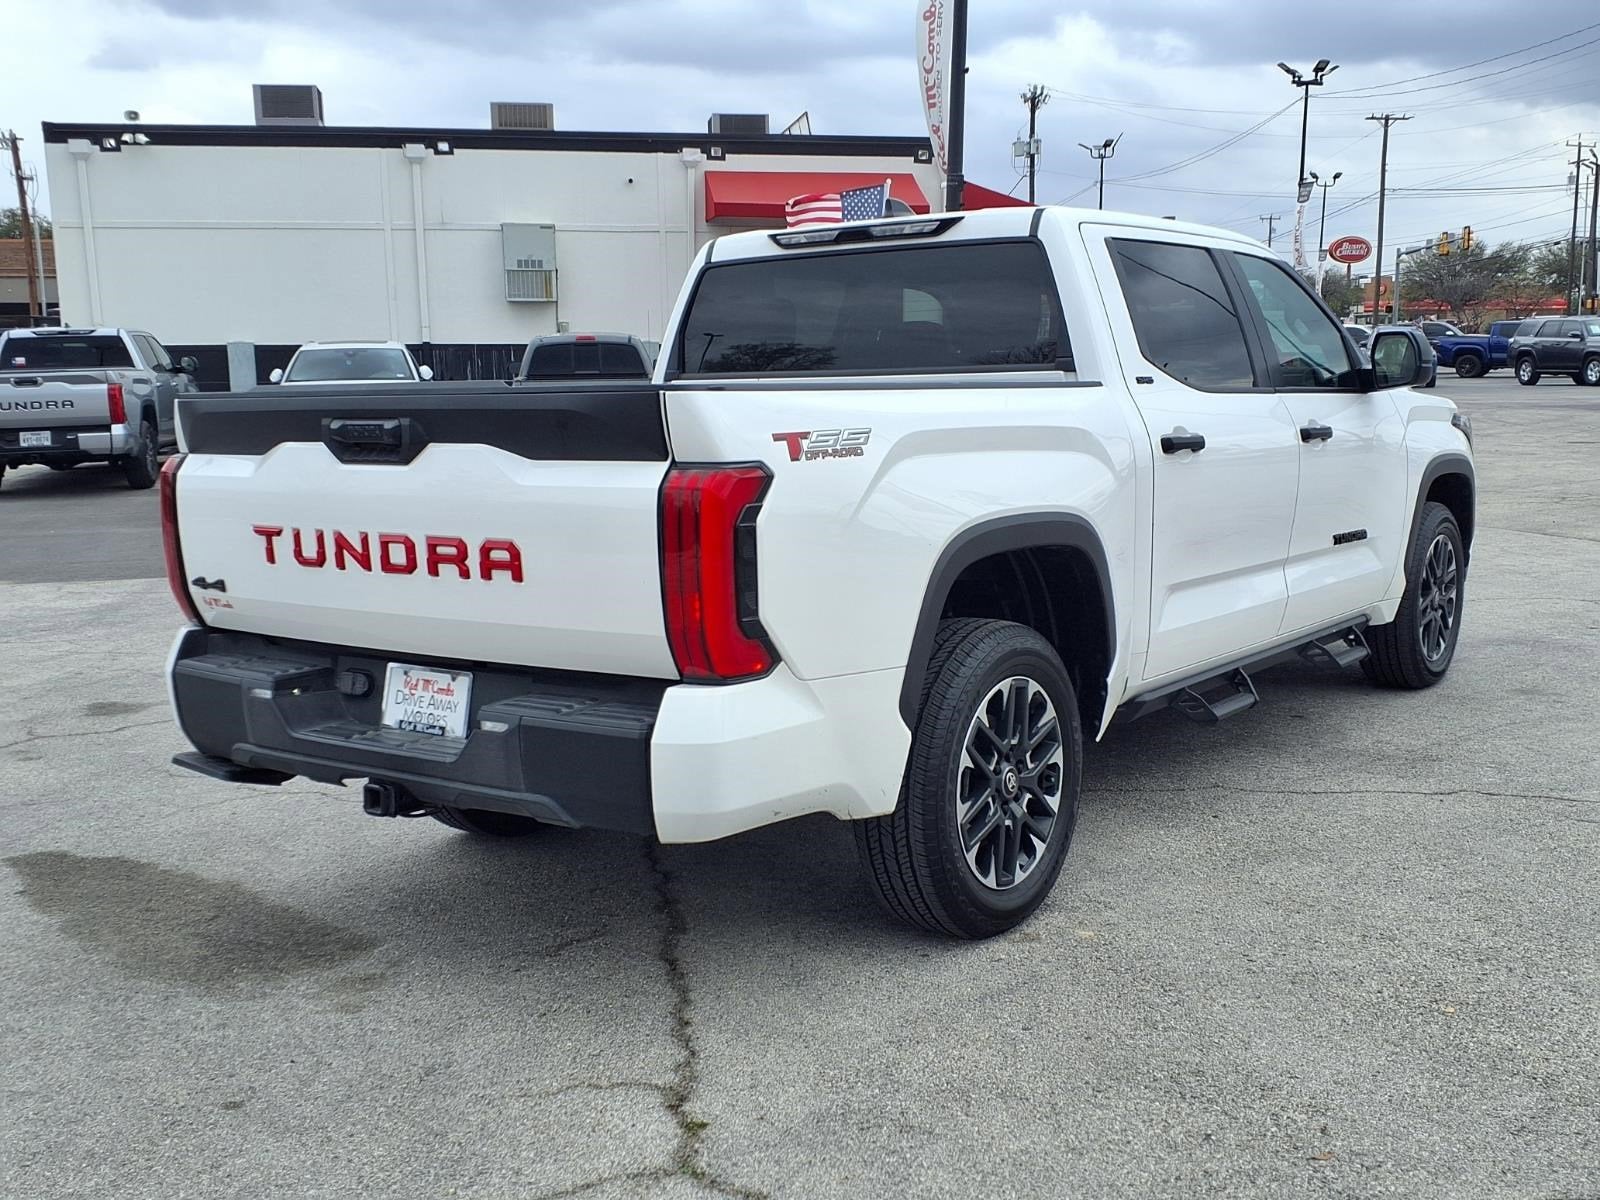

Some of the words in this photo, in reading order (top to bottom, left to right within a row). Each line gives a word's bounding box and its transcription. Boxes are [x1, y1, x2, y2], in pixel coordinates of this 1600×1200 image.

[935, 43, 941, 64] TO
[251, 524, 525, 584] TUNDRA
[404, 674, 419, 696] Red
[395, 689, 425, 709] DRIVE
[426, 695, 460, 714] AWAY
[402, 707, 448, 728] MOTORS
